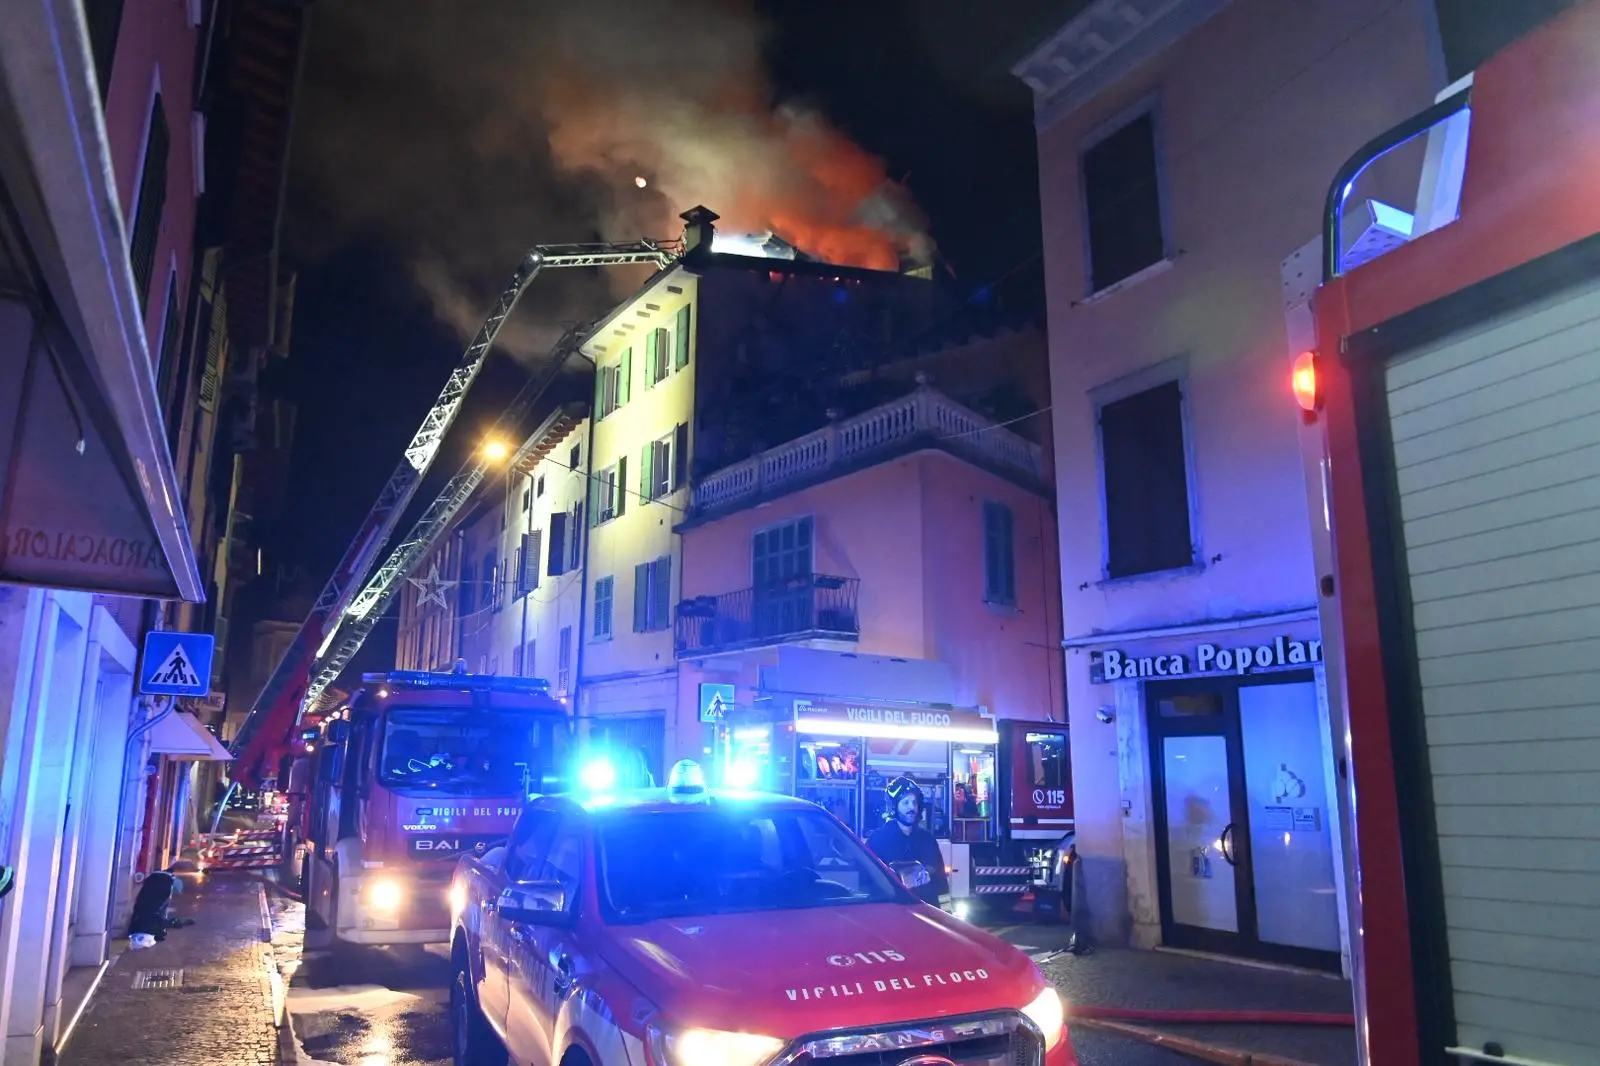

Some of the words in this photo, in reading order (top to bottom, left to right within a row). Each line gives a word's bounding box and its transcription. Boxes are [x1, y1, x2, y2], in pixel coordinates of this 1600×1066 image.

[1103, 649, 1184, 680] Banca
[1197, 636, 1322, 675] Popolar
[847, 708, 881, 721] VIGILI
[885, 711, 909, 724] DEL
[911, 712, 951, 726] FUOCO
[1047, 790, 1065, 804] 115
[474, 807, 492, 816] DEL
[416, 840, 459, 850] BAI
[855, 950, 906, 964] 115
[873, 977, 916, 992] DEL
